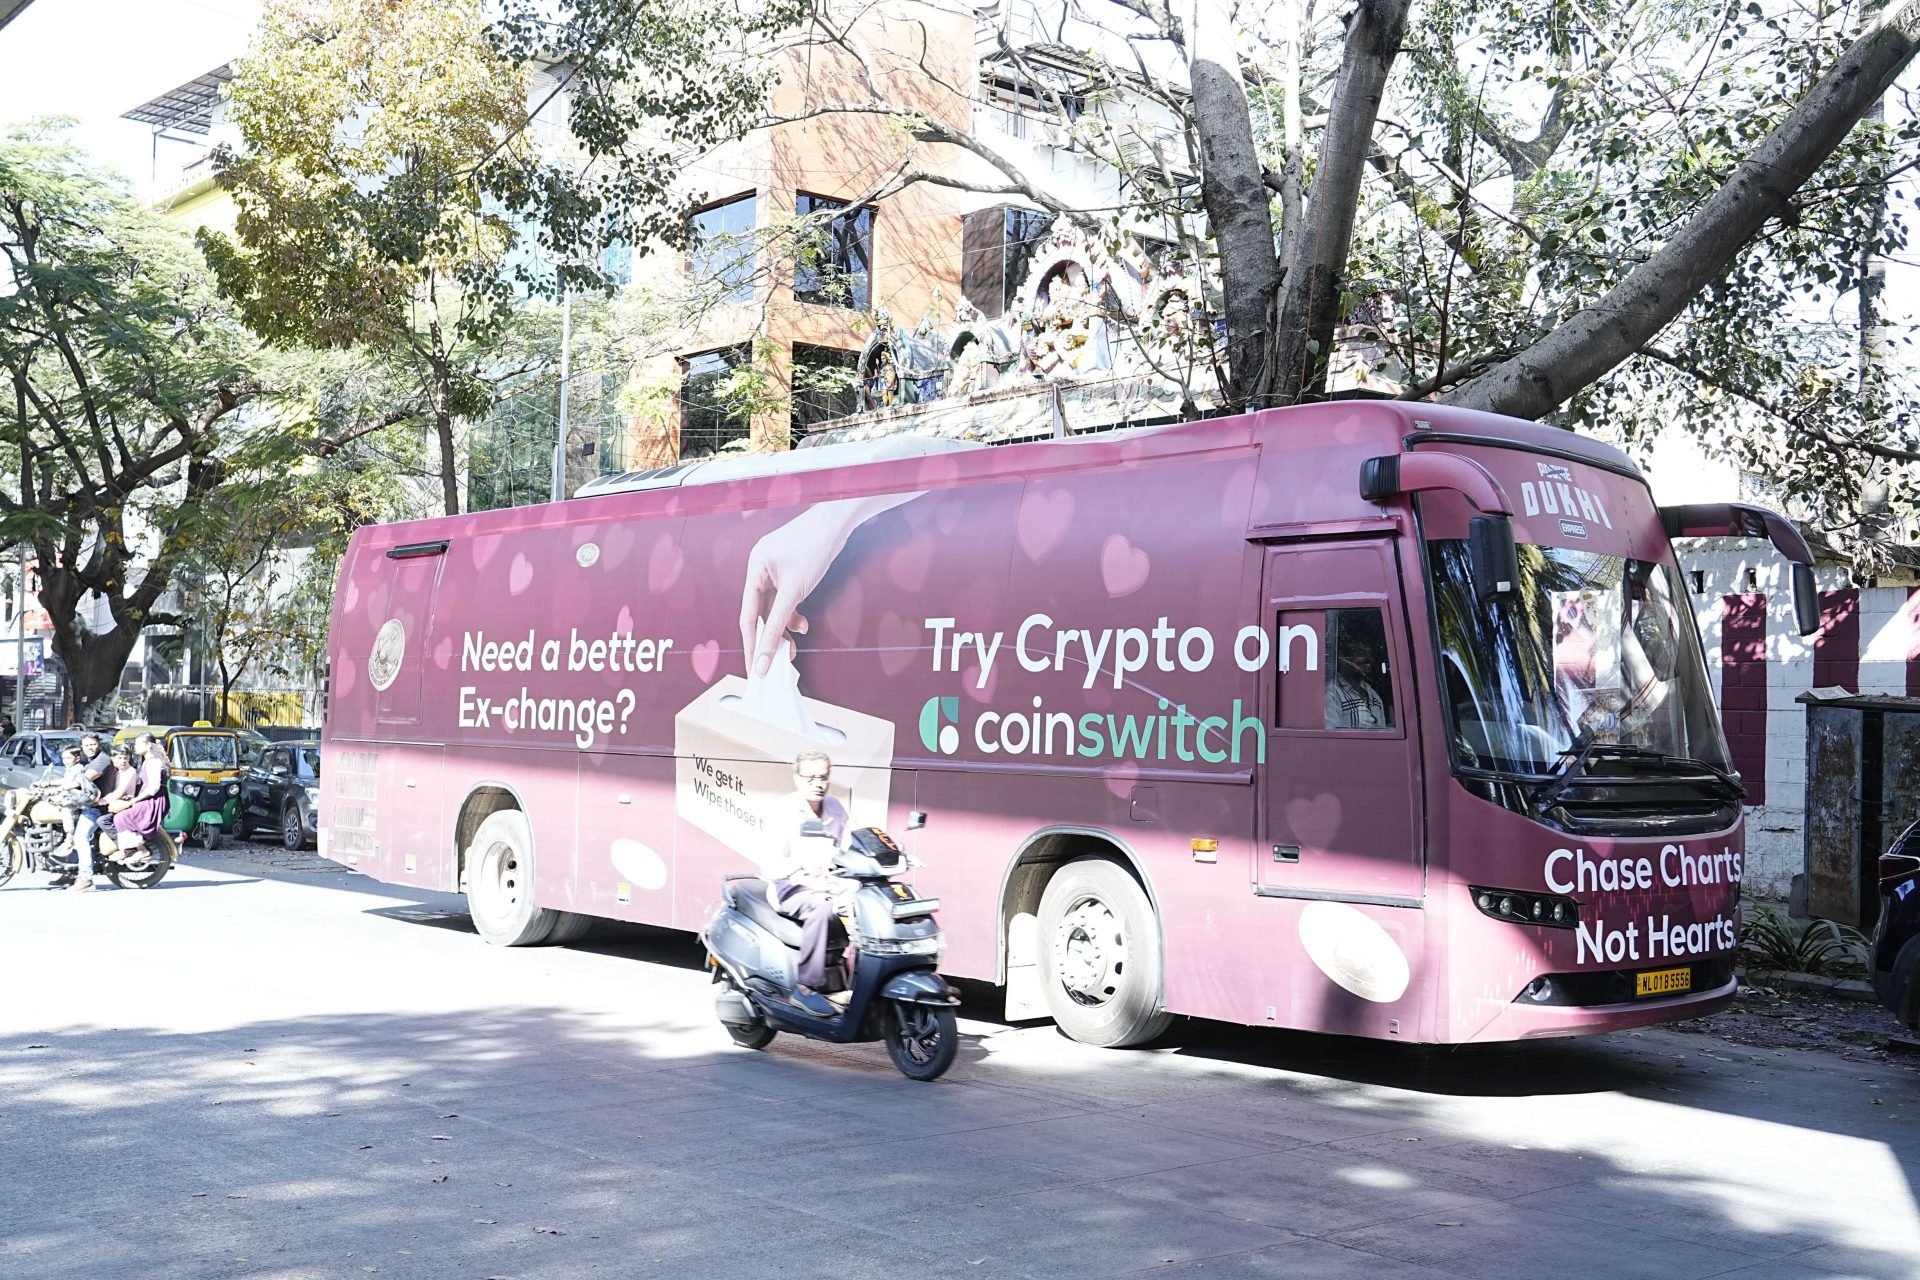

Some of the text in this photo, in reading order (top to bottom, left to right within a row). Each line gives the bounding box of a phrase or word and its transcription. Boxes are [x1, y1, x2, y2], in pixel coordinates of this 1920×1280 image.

[1521, 481, 1612, 529] DUKHI
[1560, 523, 1586, 535] EXPRESS
[461, 628, 673, 672] Need a better
[925, 613, 1318, 689] Try Crypto on
[459, 687, 636, 749] Ex-change?
[975, 696, 1266, 764] coinswitch
[693, 754, 746, 796] We get it.
[694, 777, 722, 806] Wipe
[725, 798, 756, 826] those
[1544, 849, 1652, 894] Chase
[1575, 914, 1736, 965] Not Hearts.
